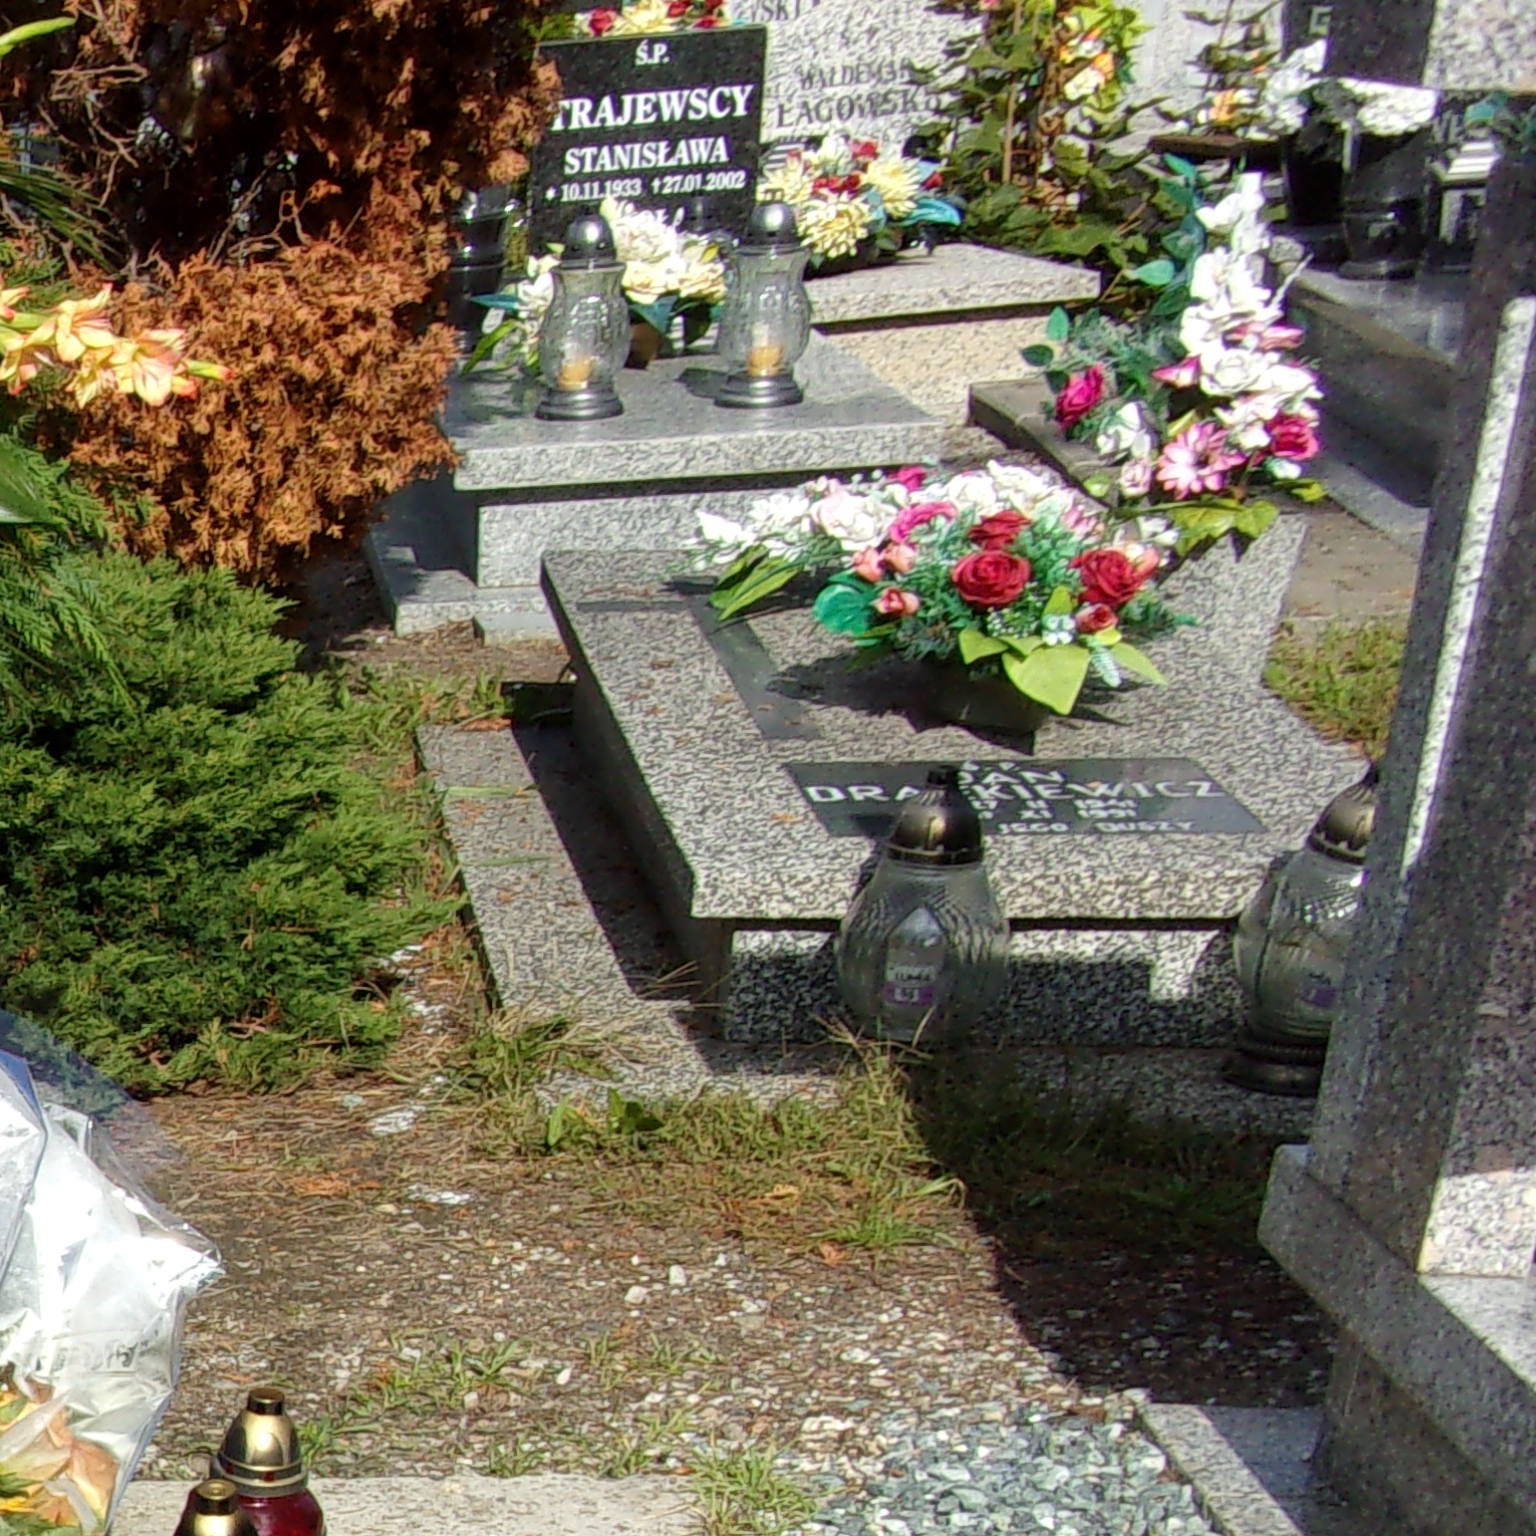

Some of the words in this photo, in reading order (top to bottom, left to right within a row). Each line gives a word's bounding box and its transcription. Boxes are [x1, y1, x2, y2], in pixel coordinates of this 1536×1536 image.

[635, 39, 670, 65] Ś.P.
[564, 136, 730, 175] STANISŁAWA
[560, 178, 642, 201] 10.11.1933
[663, 170, 747, 194] 27.01.2002
